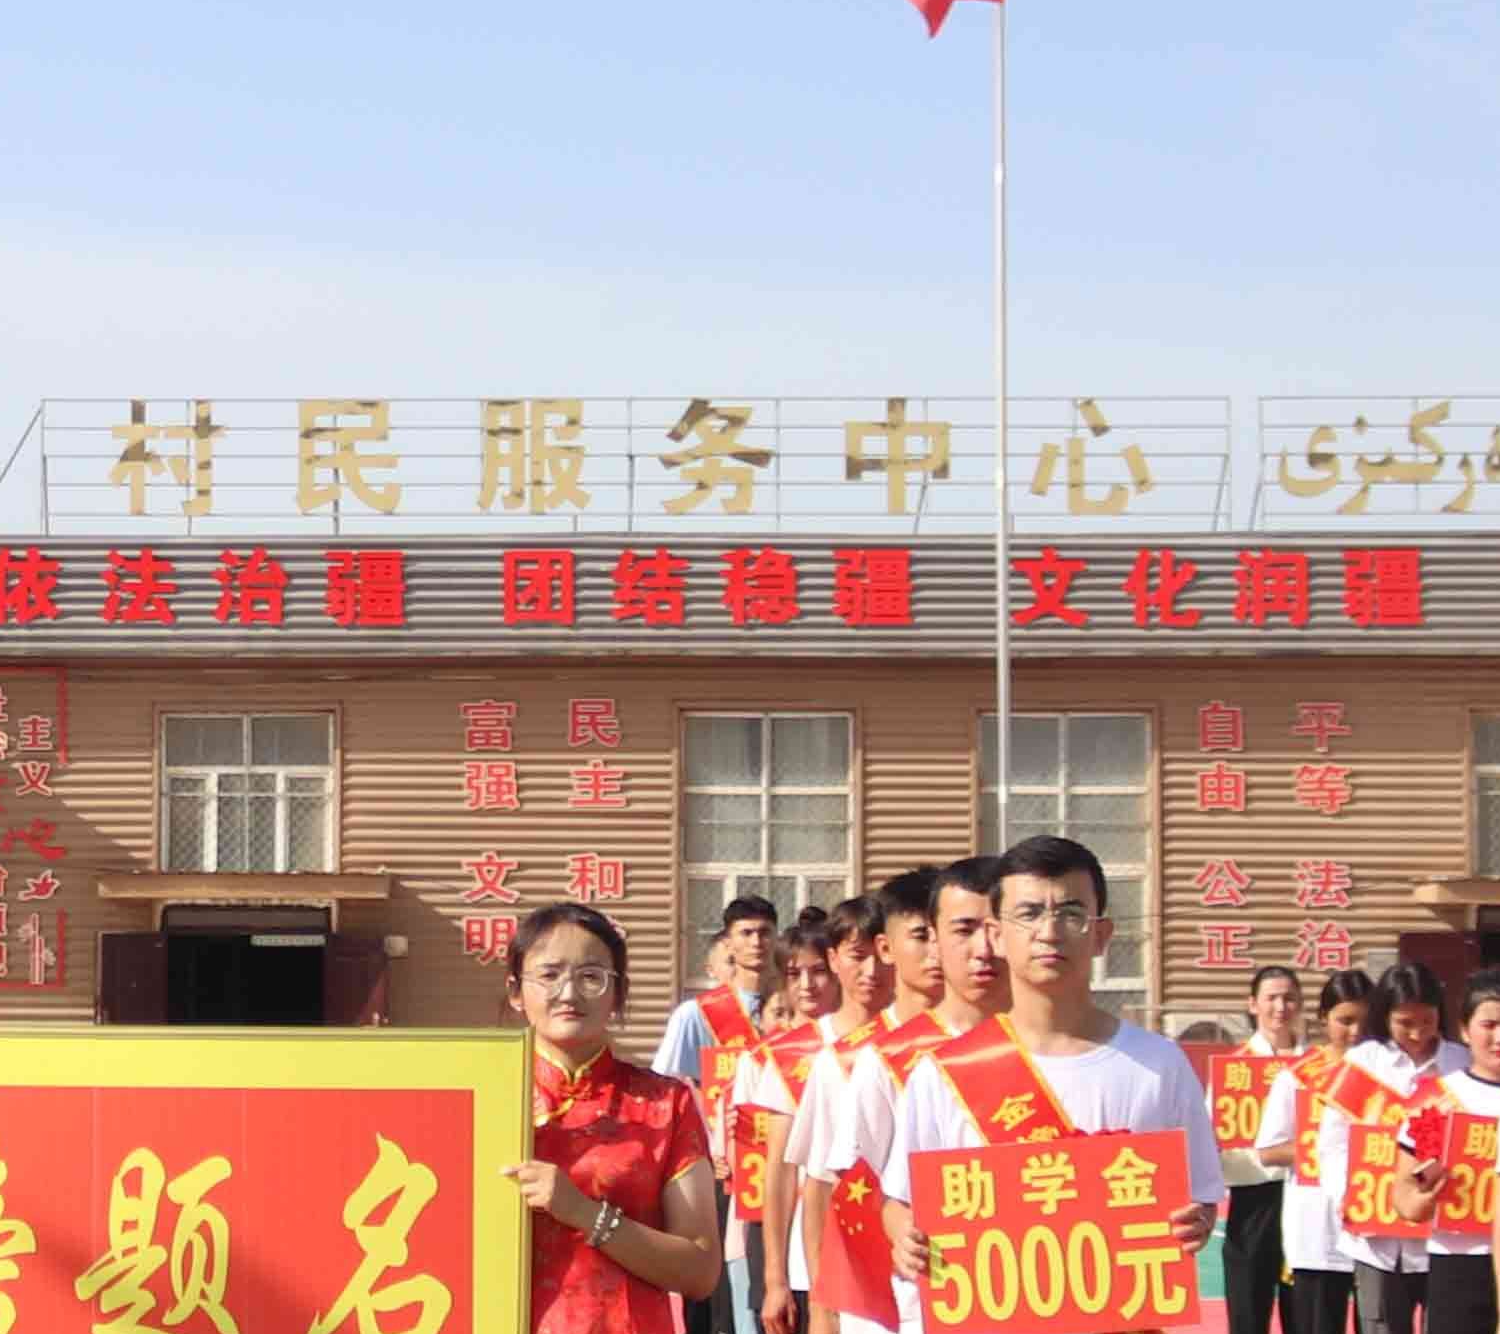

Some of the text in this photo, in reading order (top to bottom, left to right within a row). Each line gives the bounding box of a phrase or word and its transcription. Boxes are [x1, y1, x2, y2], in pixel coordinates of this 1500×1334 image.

[112, 398, 1155, 515] 村民服务中心
[504, 548, 914, 627] 团结稳疆
[1009, 548, 1421, 627] 文化润疆
[16, 715, 53, 796] 主义
[567, 698, 629, 808] 民主
[458, 699, 521, 964] 富强 文明
[1194, 700, 1254, 969] 自由 公正
[1290, 701, 1353, 970] 平等 法治
[941, 1147, 1158, 1220] 助学金
[928, 1221, 1187, 1325] 5000元
